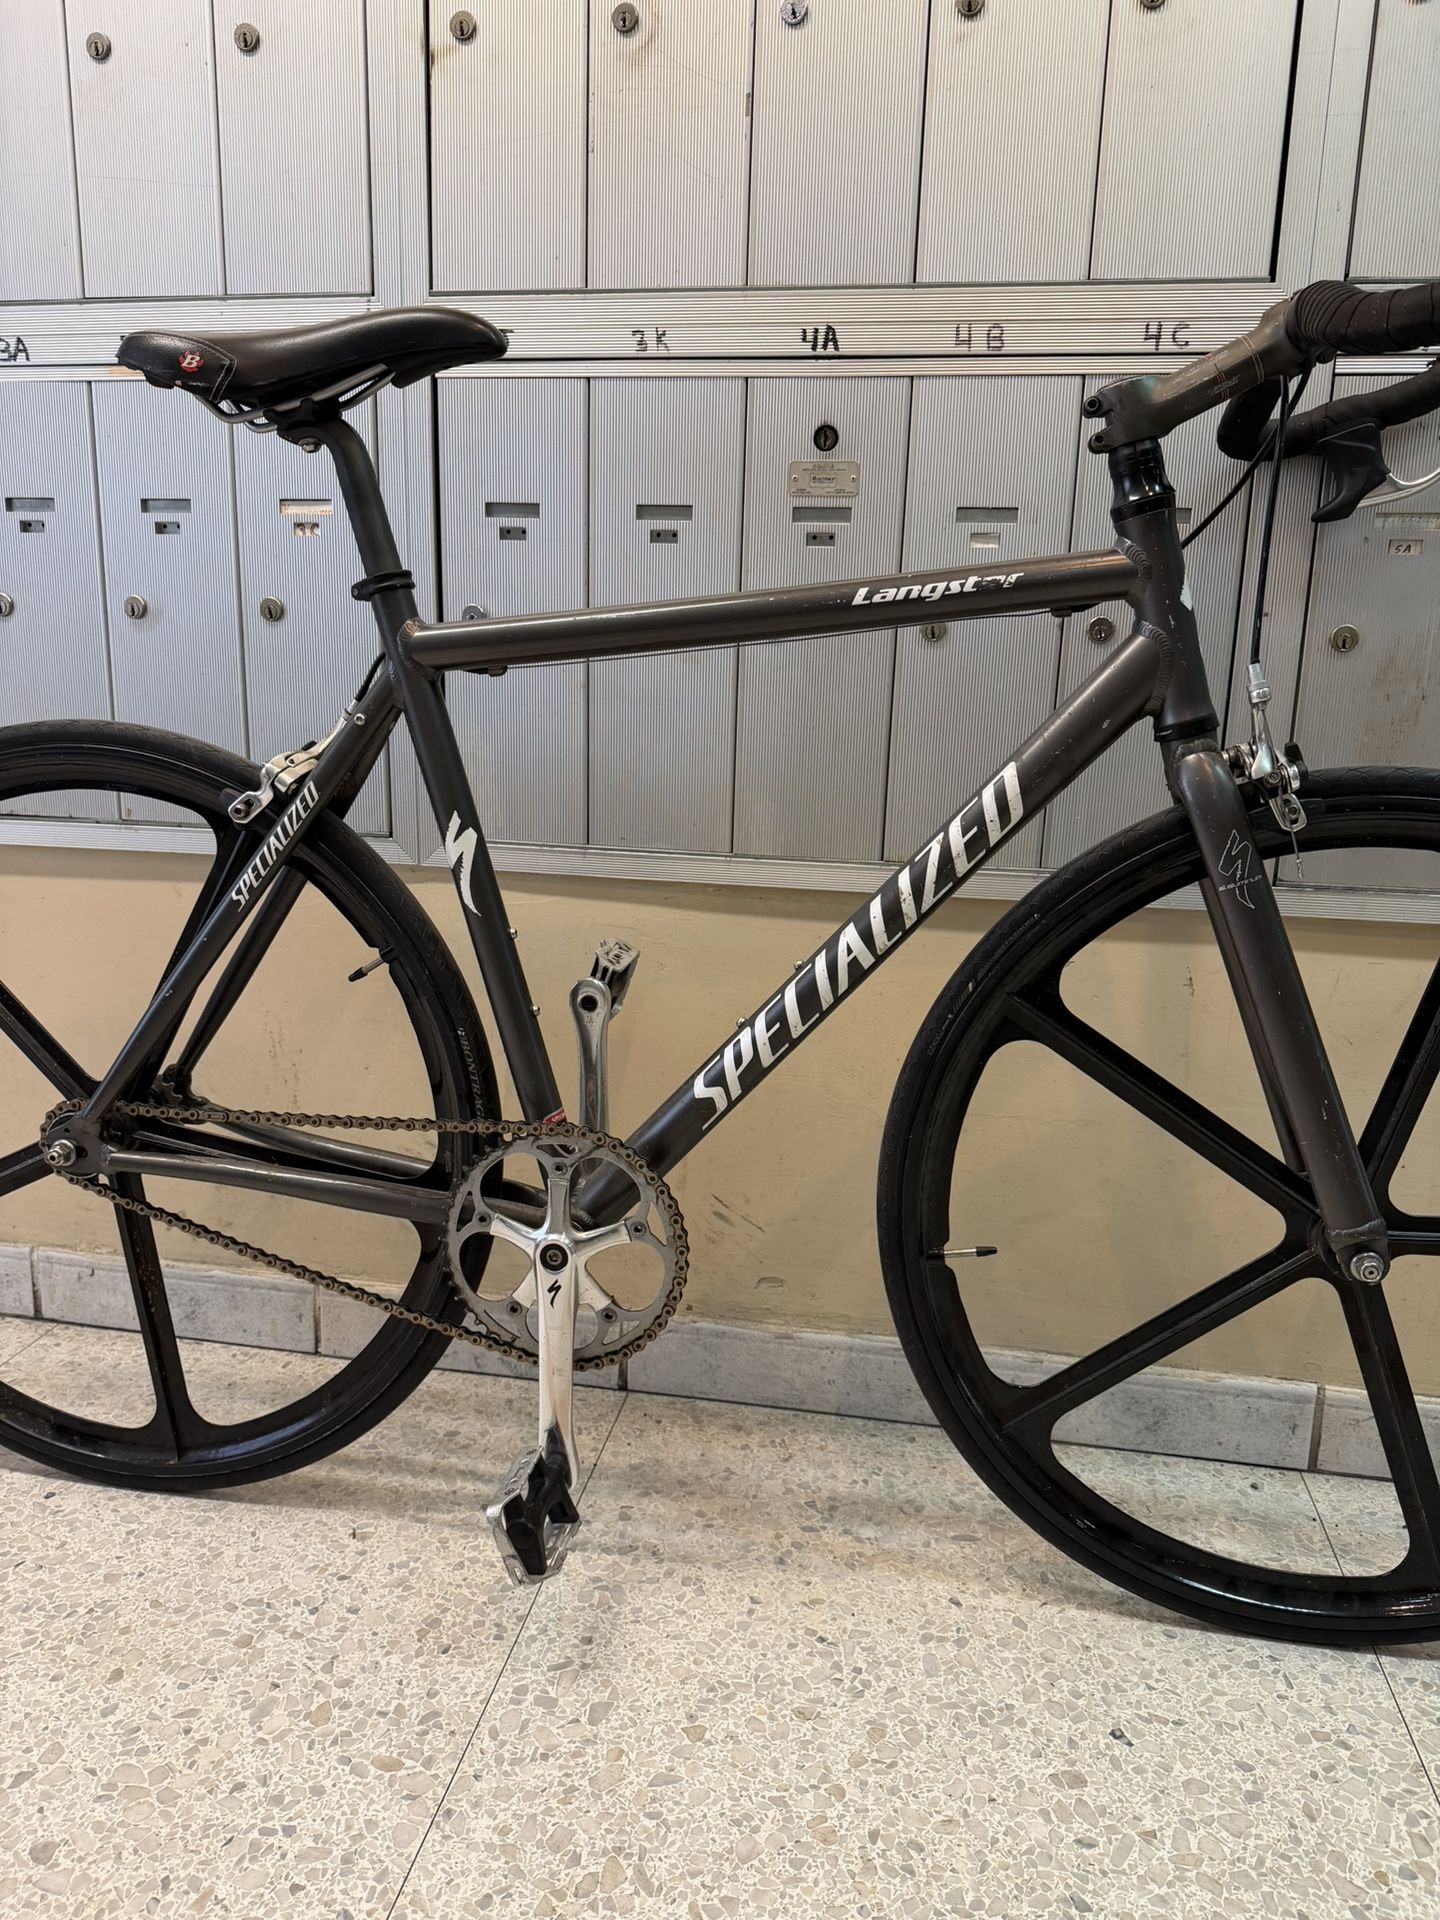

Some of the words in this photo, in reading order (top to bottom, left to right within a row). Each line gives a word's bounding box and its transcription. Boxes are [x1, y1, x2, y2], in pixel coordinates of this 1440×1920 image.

[801, 324, 840, 352] 4A
[1394, 544, 1412, 554] 5A
[231, 780, 320, 913] SPECIALIZED
[693, 761, 1025, 1131] SPECIALIZED
[460, 1039, 486, 1120] BONTRAG
